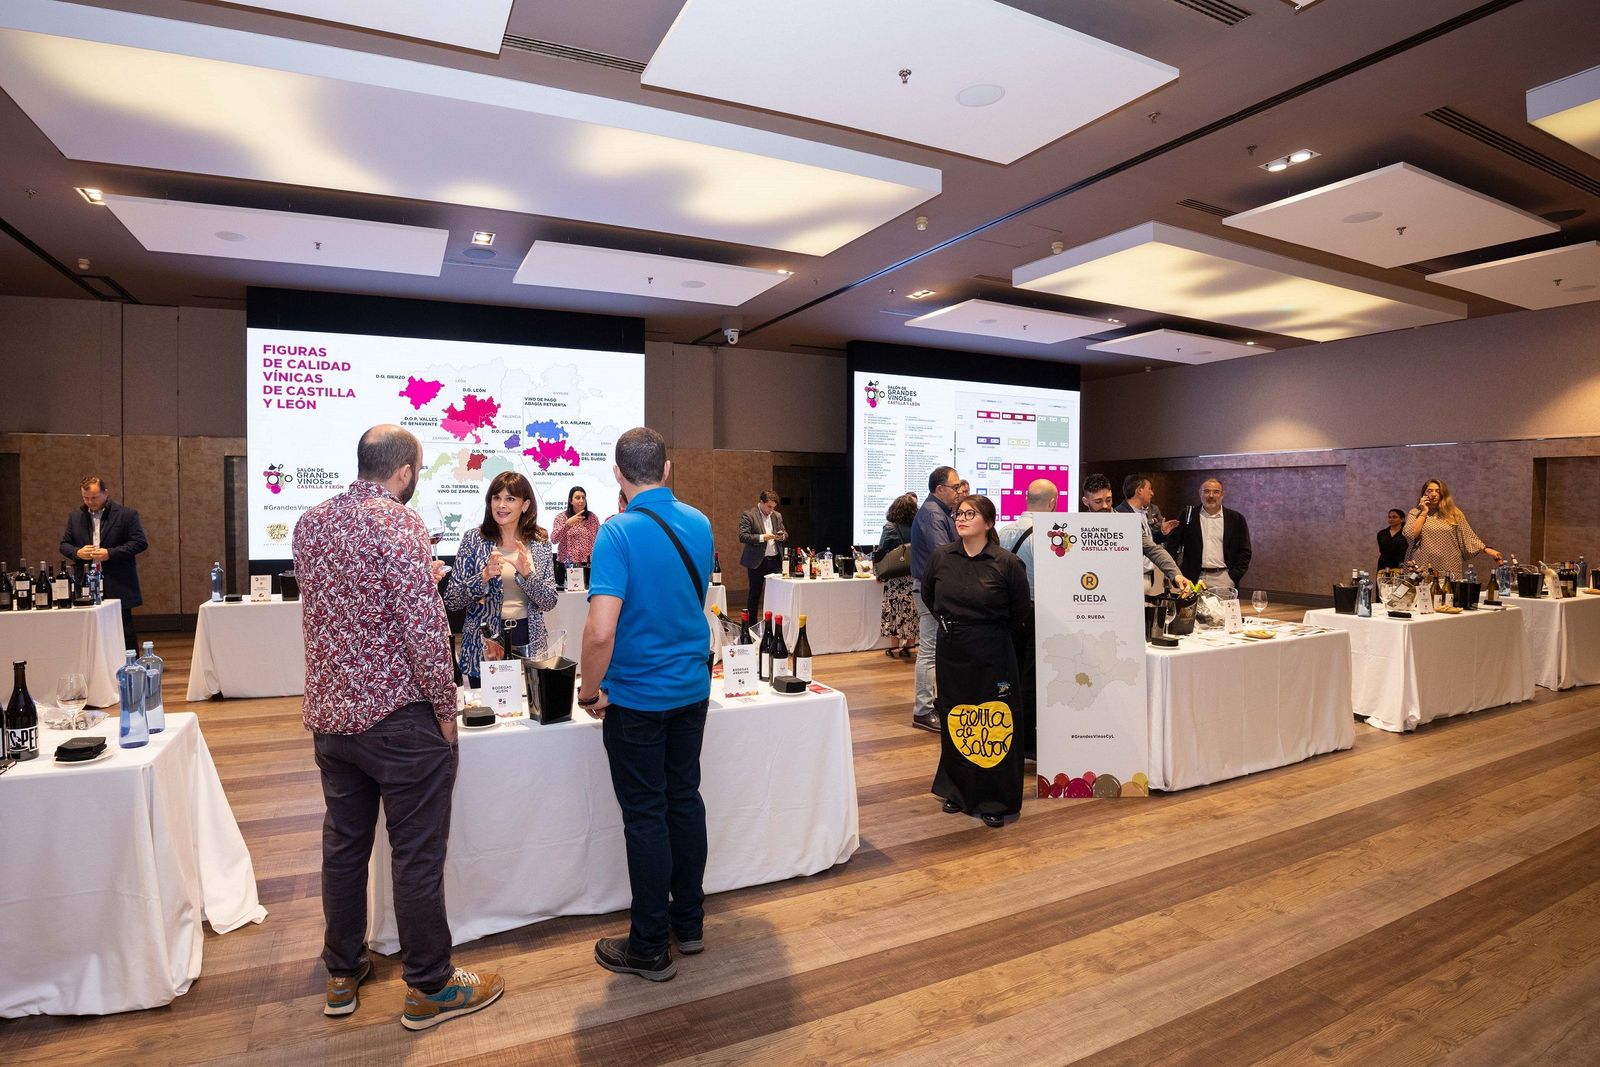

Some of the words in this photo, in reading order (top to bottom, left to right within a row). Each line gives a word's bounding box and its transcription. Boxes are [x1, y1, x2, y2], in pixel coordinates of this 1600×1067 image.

[263, 344, 327, 357] FIGURAS
[263, 358, 282, 368] DE
[287, 359, 351, 371] CALIDAD
[262, 369, 323, 383] VÍNICAS
[263, 385, 282, 395] DE
[286, 386, 356, 398] CASTILLA
[262, 398, 273, 408] Y
[277, 397, 316, 410] LEÓN
[1086, 576, 1094, 586] R
[1073, 594, 1107, 602] RUEDA
[950, 708, 1012, 728] tierra
[956, 726, 975, 738] de
